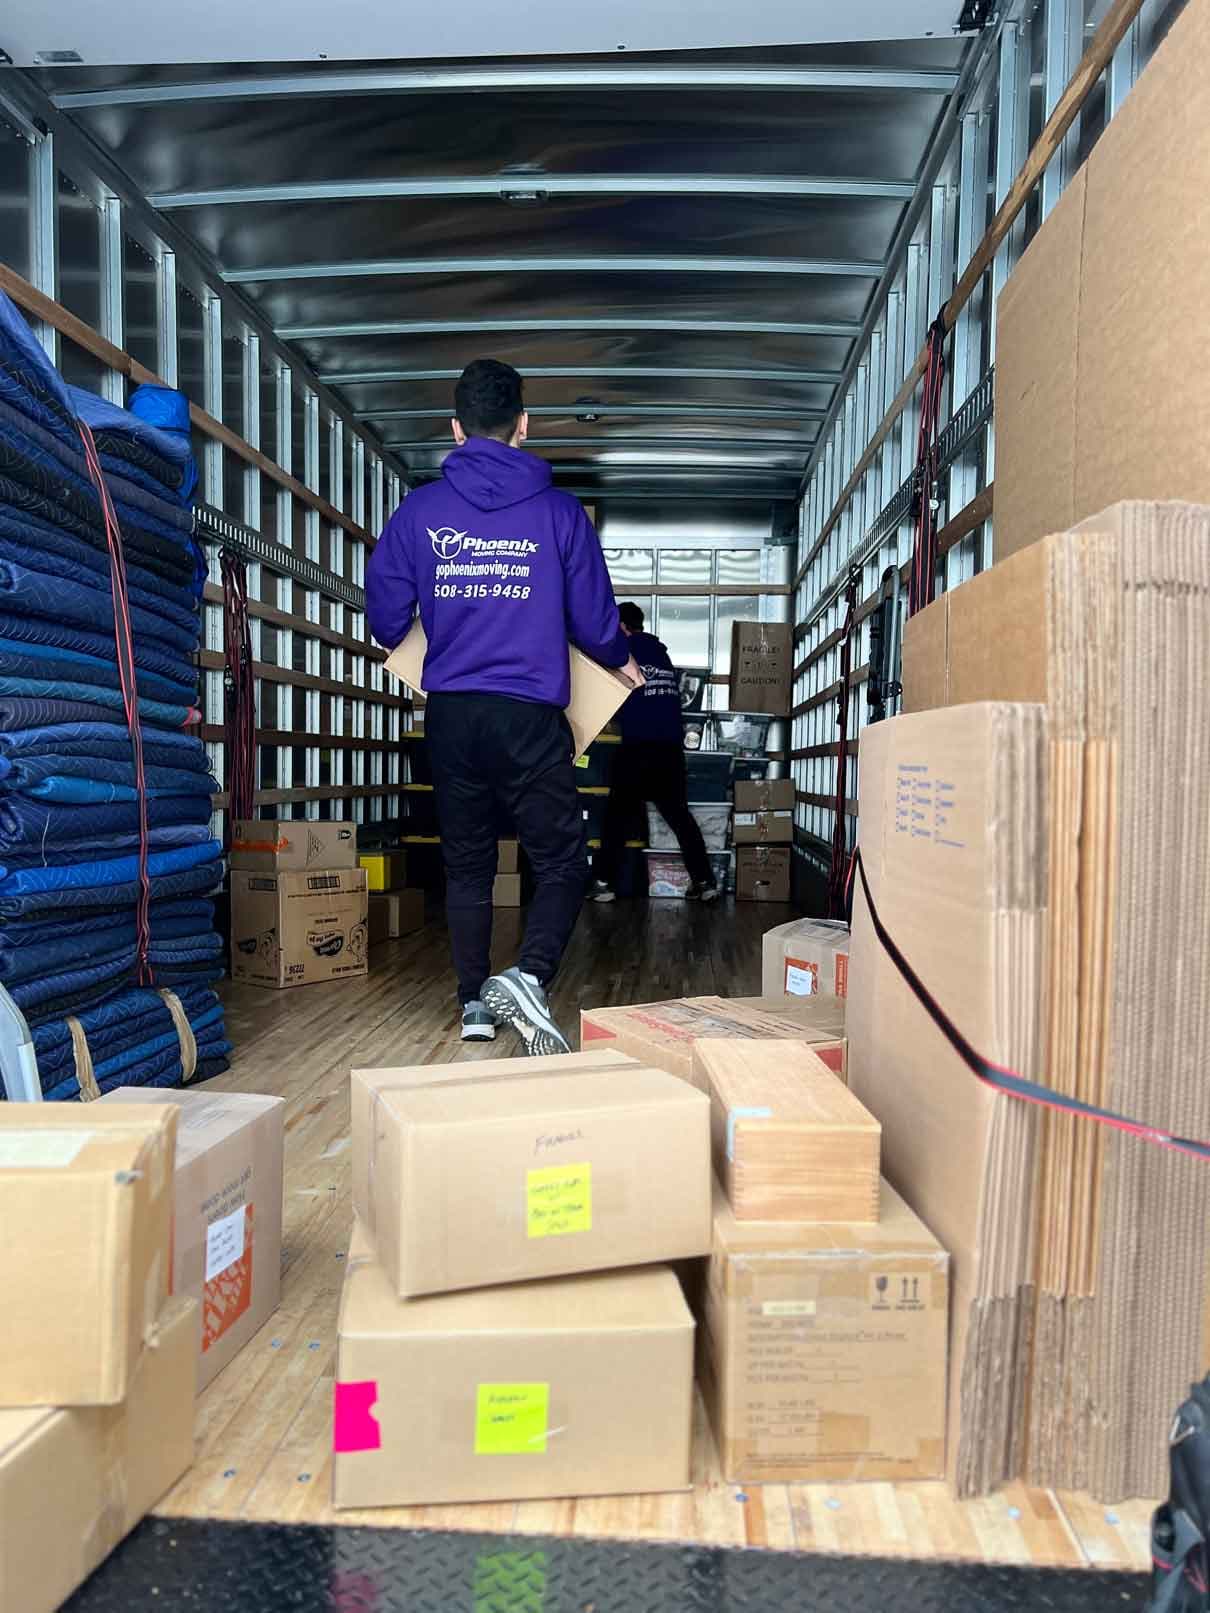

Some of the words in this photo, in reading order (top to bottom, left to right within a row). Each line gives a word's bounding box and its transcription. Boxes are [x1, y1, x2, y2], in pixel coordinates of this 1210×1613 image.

[462, 537, 540, 552] Phoenix
[471, 550, 495, 558] MOVING
[496, 550, 529, 558] COMPANY
[435, 559, 530, 580] gophoenixmoving.com
[434, 583, 531, 600] 508-315-9458
